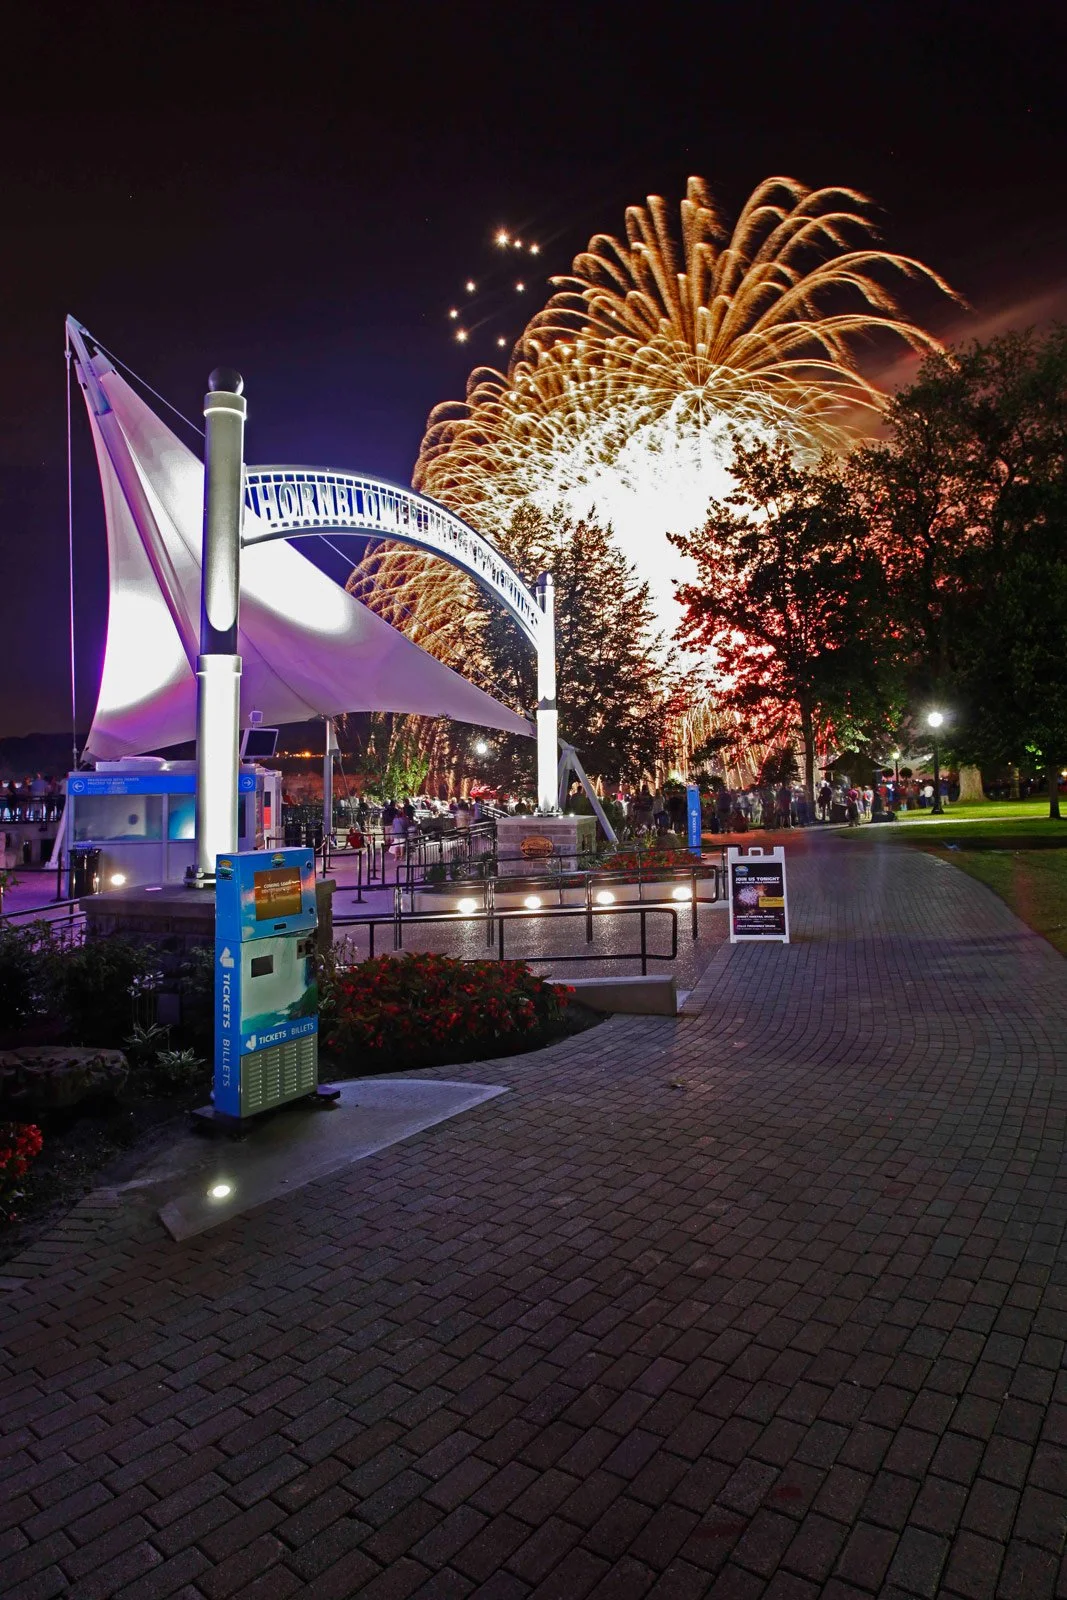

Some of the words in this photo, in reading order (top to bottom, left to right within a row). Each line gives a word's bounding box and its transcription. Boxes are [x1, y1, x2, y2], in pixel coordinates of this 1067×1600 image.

[258, 482, 420, 528] HORNBLOWER
[222, 973, 231, 1029] TICKETS
[259, 1030, 287, 1045] TICKETS
[291, 1022, 314, 1035] BILLETS
[222, 1038, 231, 1087] BILLETS
